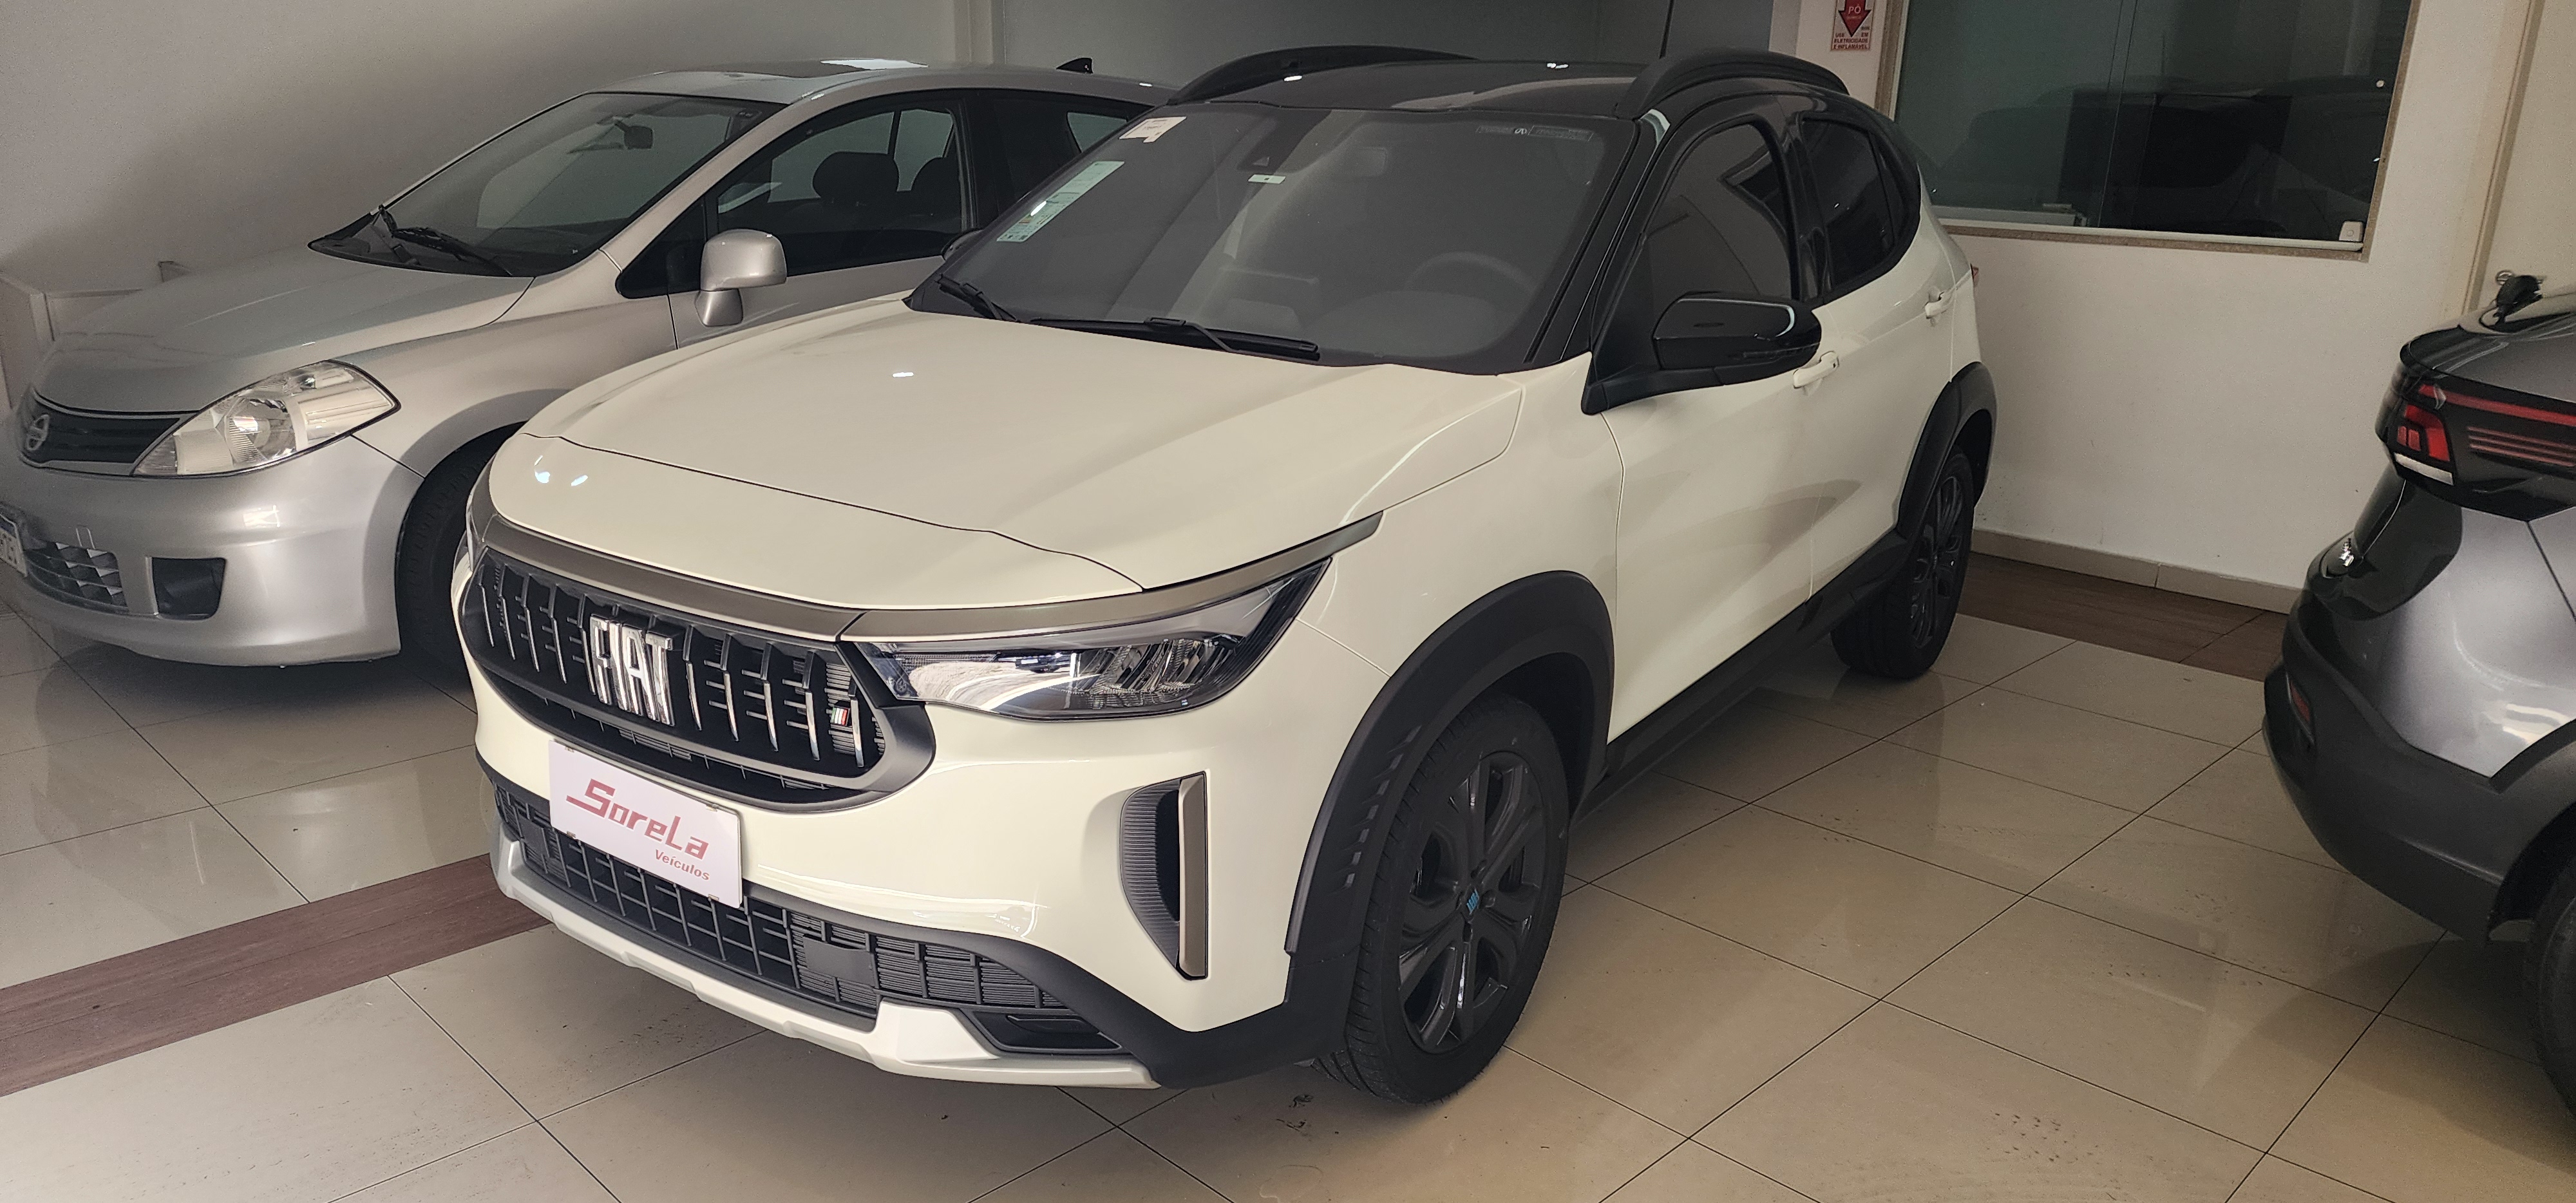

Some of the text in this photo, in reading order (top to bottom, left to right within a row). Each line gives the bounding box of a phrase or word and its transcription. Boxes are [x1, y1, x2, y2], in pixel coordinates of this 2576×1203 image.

[1848, 4, 1861, 15] PÓ
[590, 615, 674, 726] FIAT
[655, 849, 710, 880] Veículos
